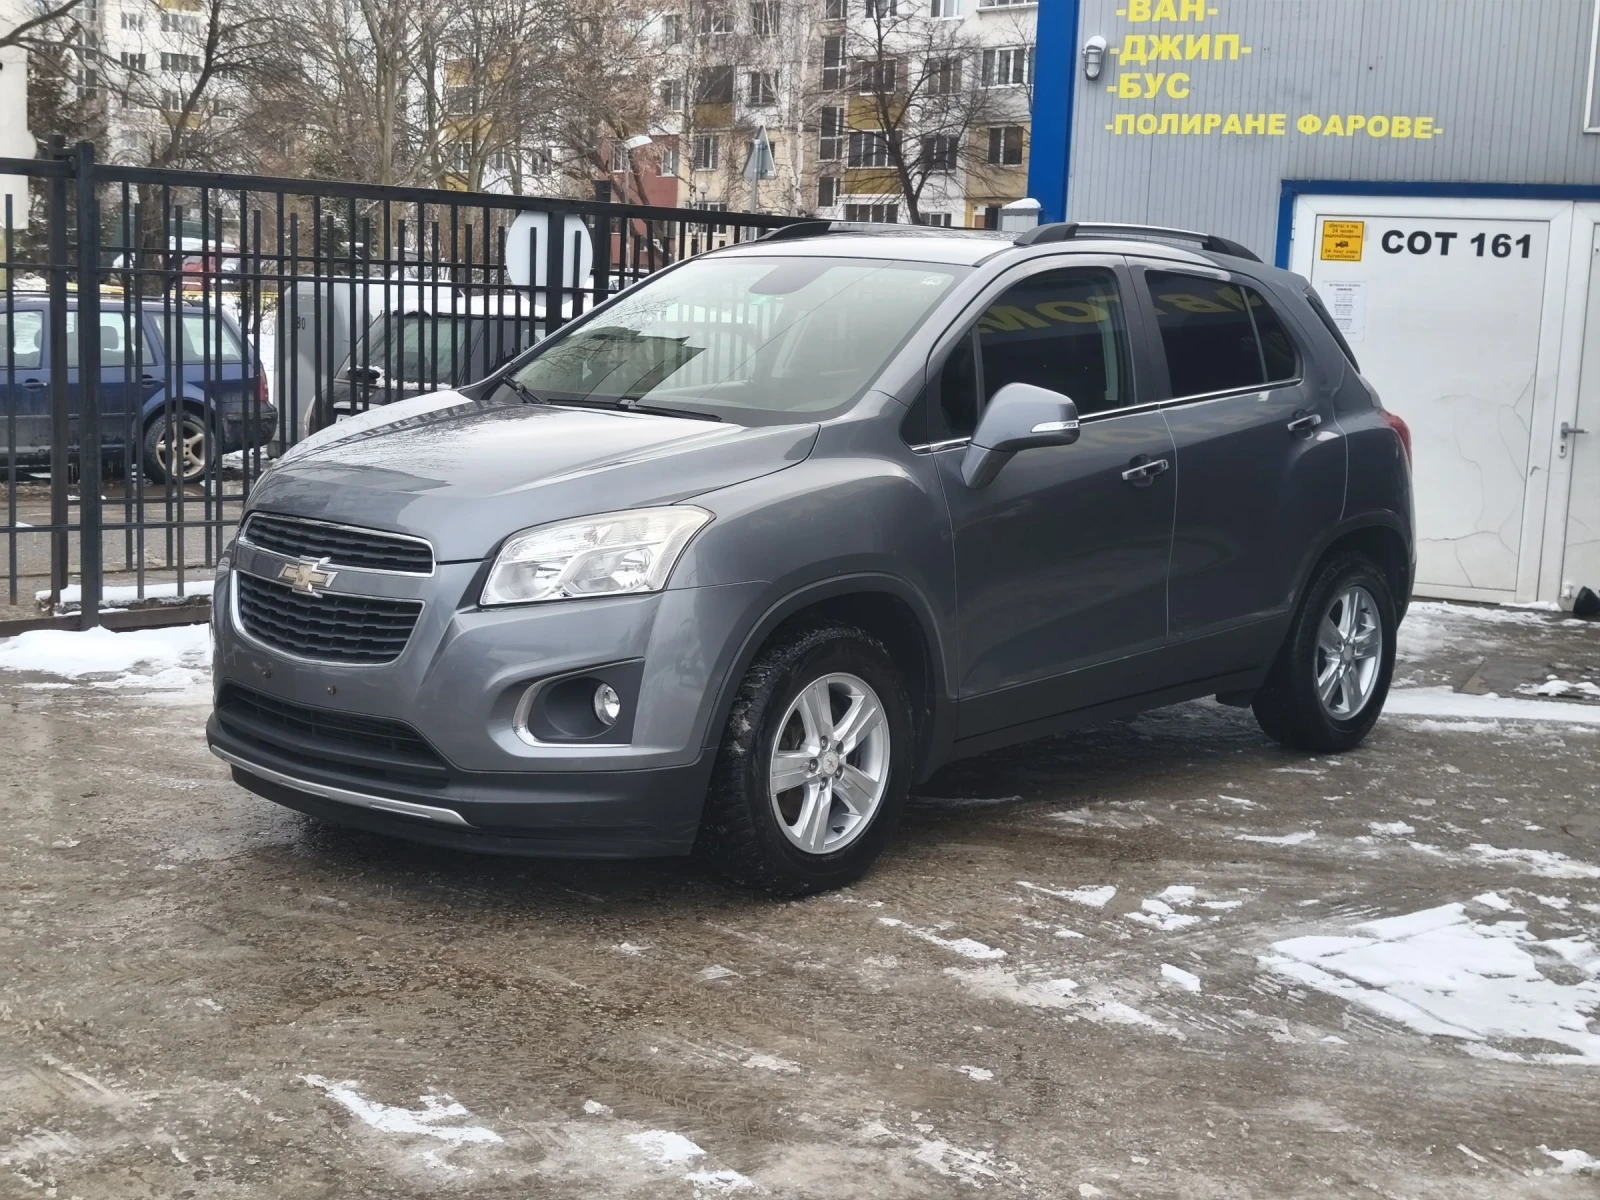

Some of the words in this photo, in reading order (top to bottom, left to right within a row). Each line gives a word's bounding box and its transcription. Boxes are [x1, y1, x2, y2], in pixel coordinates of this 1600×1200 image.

[1116, 0, 1218, 22] -ВАН-
[1110, 34, 1252, 66] -ДЖИП-
[1107, 72, 1190, 99] -БУС
[1105, 113, 1287, 135] -ПОЛИРАНЕ
[1297, 113, 1443, 139] ФАРОВЕ-
[1381, 230, 1458, 256] СОТ
[1470, 233, 1531, 258] 161
